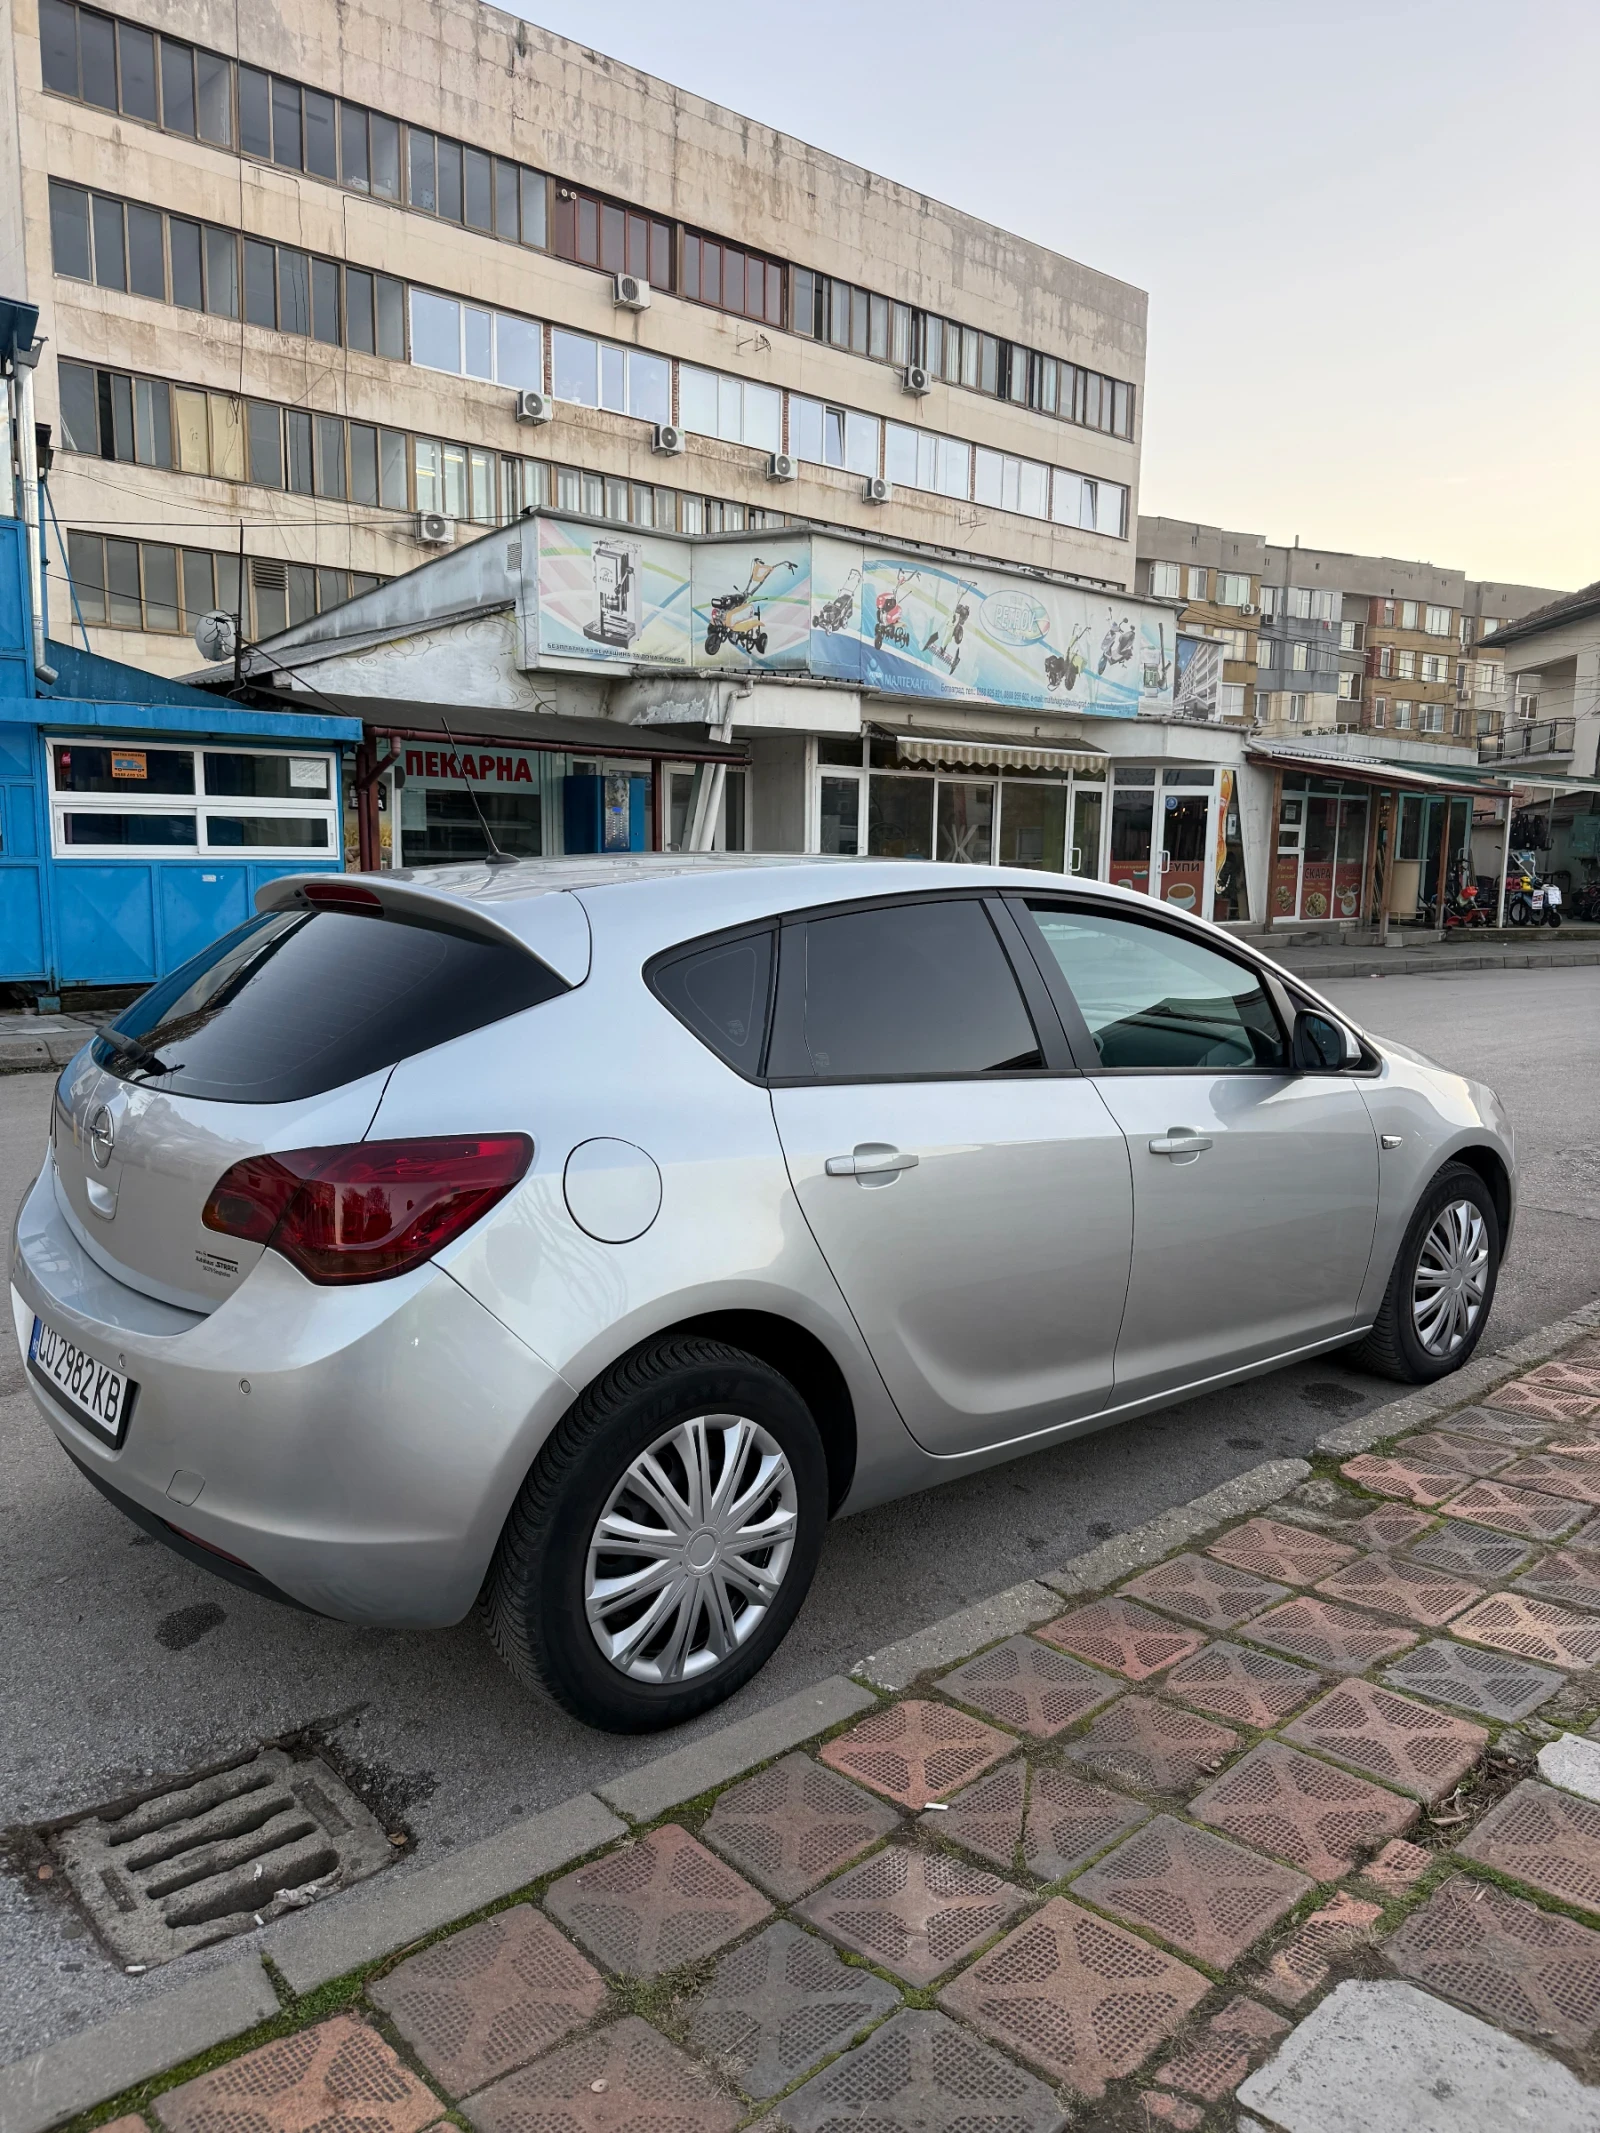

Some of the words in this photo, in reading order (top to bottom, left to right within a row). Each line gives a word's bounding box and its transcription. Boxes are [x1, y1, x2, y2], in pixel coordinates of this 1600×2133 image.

[994, 604, 1036, 632] PETROV
[884, 674, 934, 690] МАЛТЕХАГРО
[405, 750, 533, 782] ПЕКАРНА
[1304, 868, 1331, 879] СКАРА
